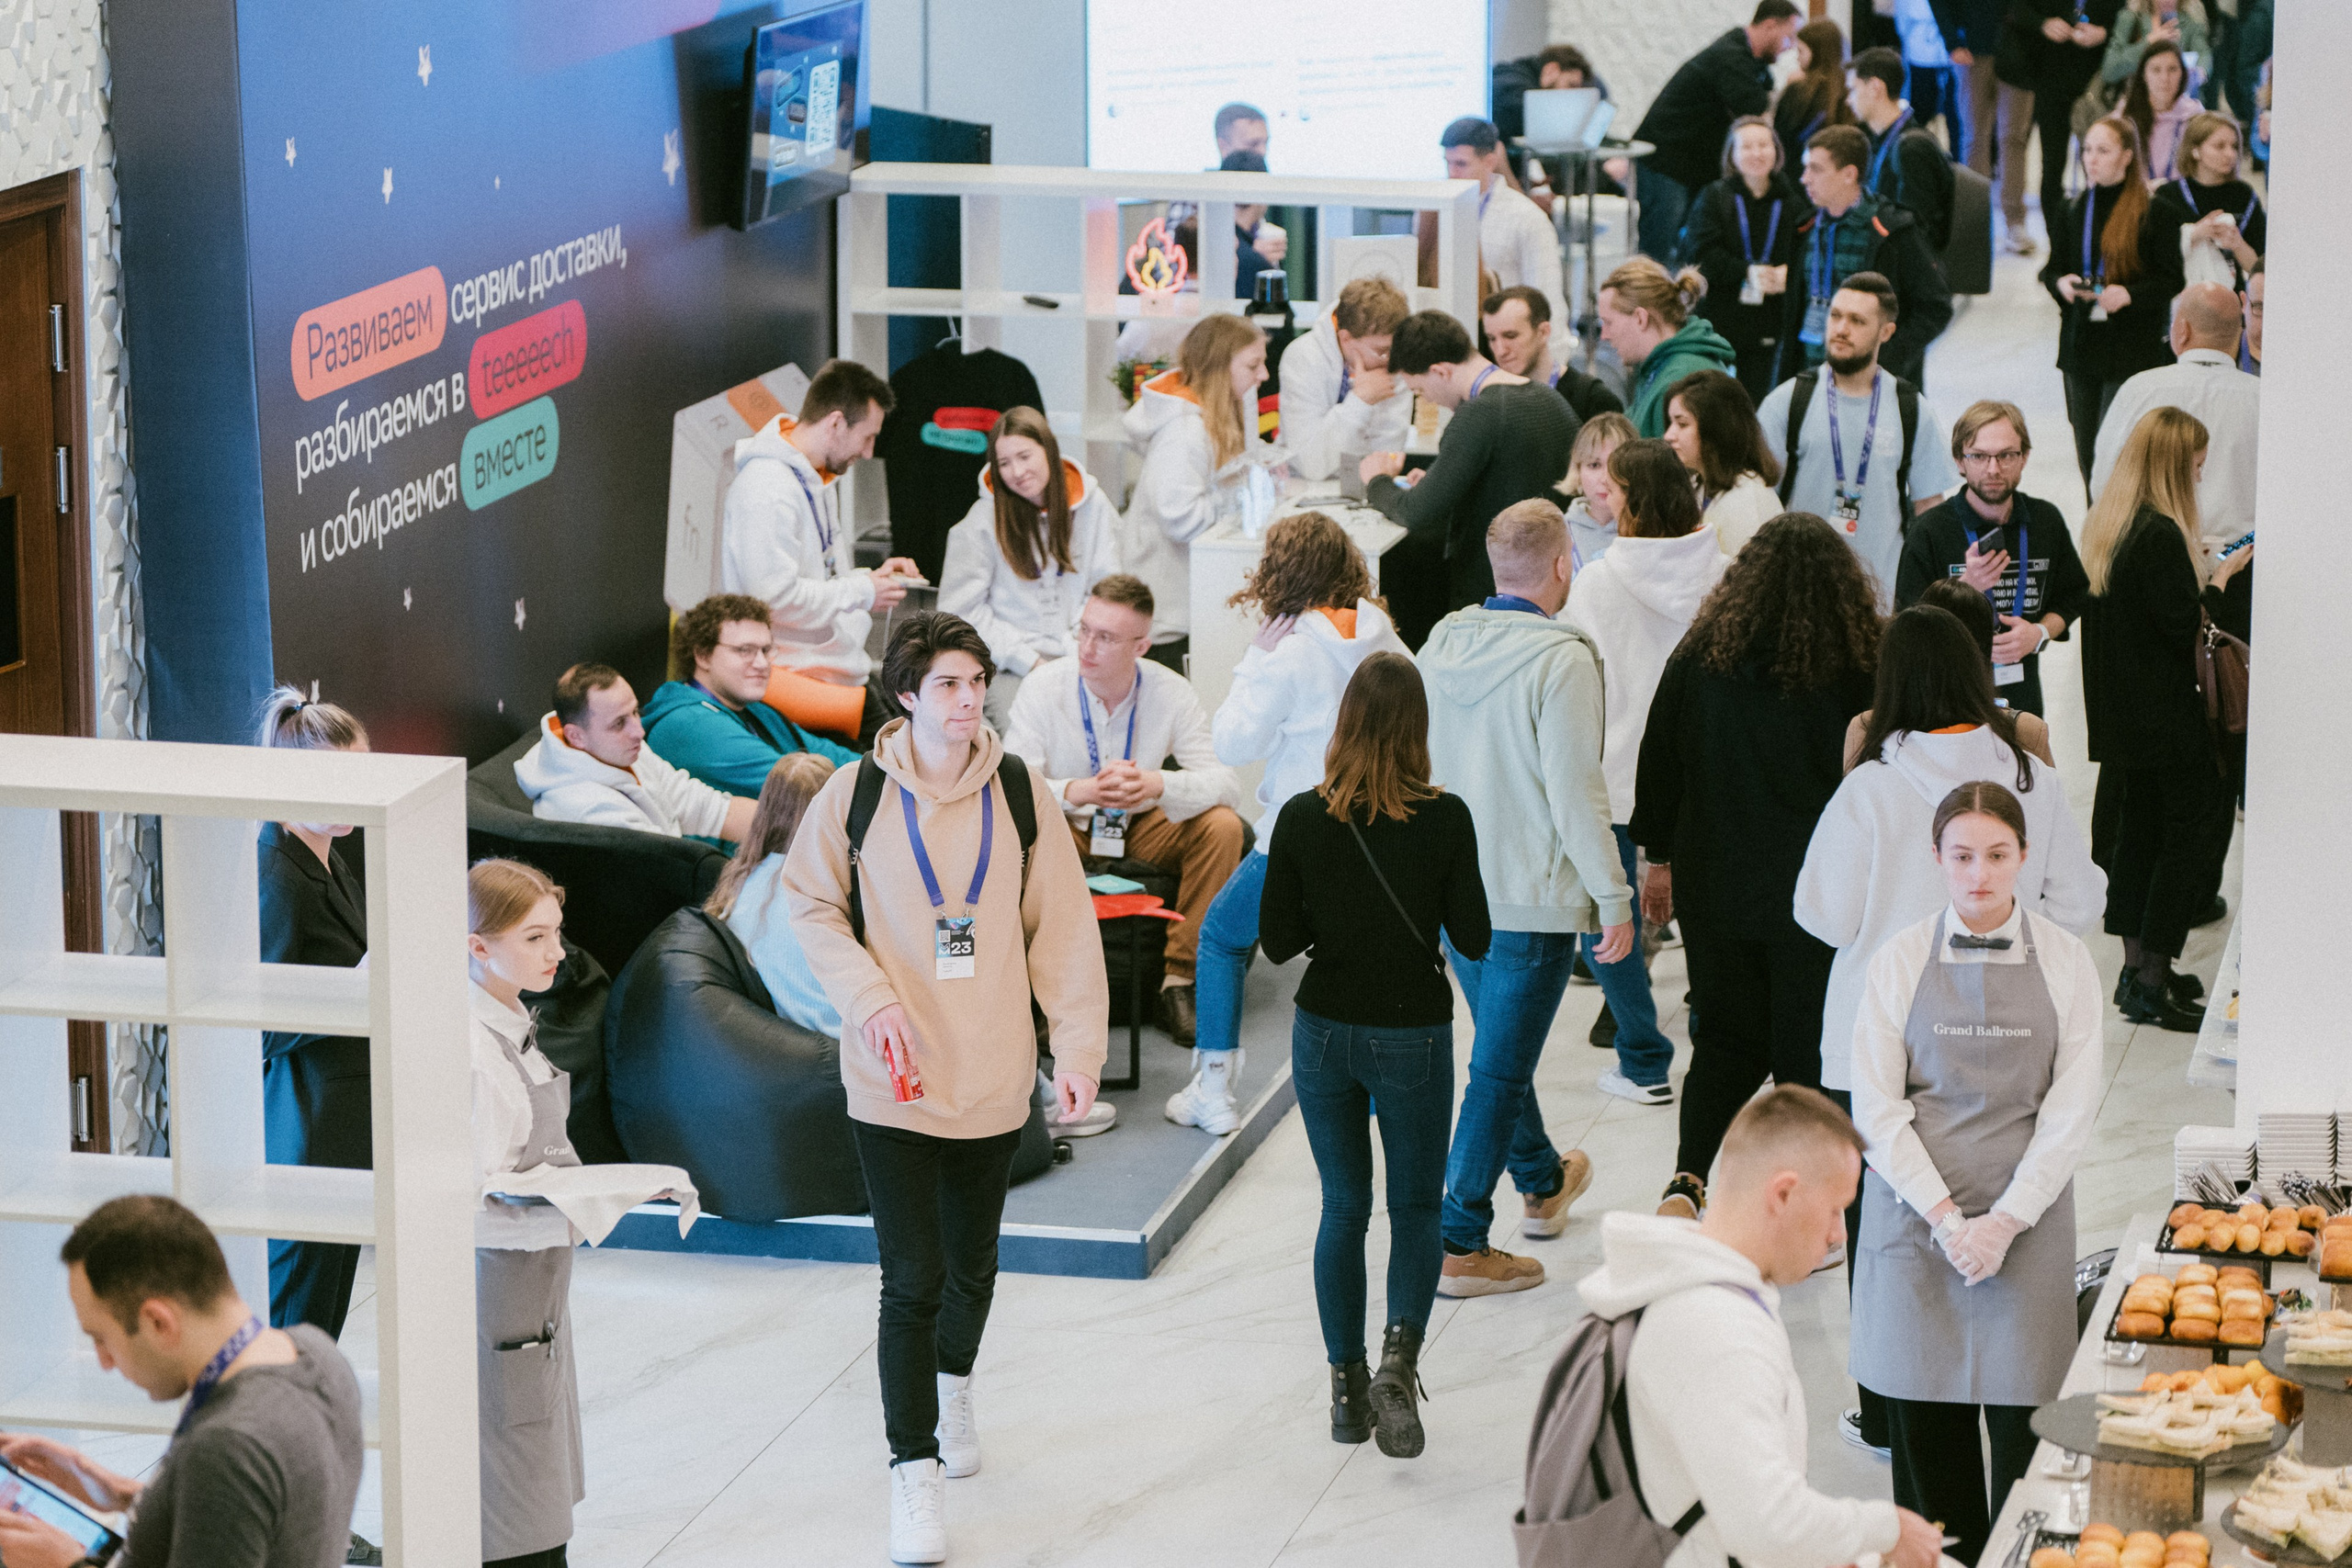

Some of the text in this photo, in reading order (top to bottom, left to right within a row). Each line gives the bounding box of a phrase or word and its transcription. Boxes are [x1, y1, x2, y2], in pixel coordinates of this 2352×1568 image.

[306, 223, 628, 380] Развиваем сервис доставки,
[295, 314, 575, 494] разбираемся в teeeeech
[300, 422, 548, 574] и собираемся вместе
[1933, 1022, 2032, 1037] Grand Ballroom
